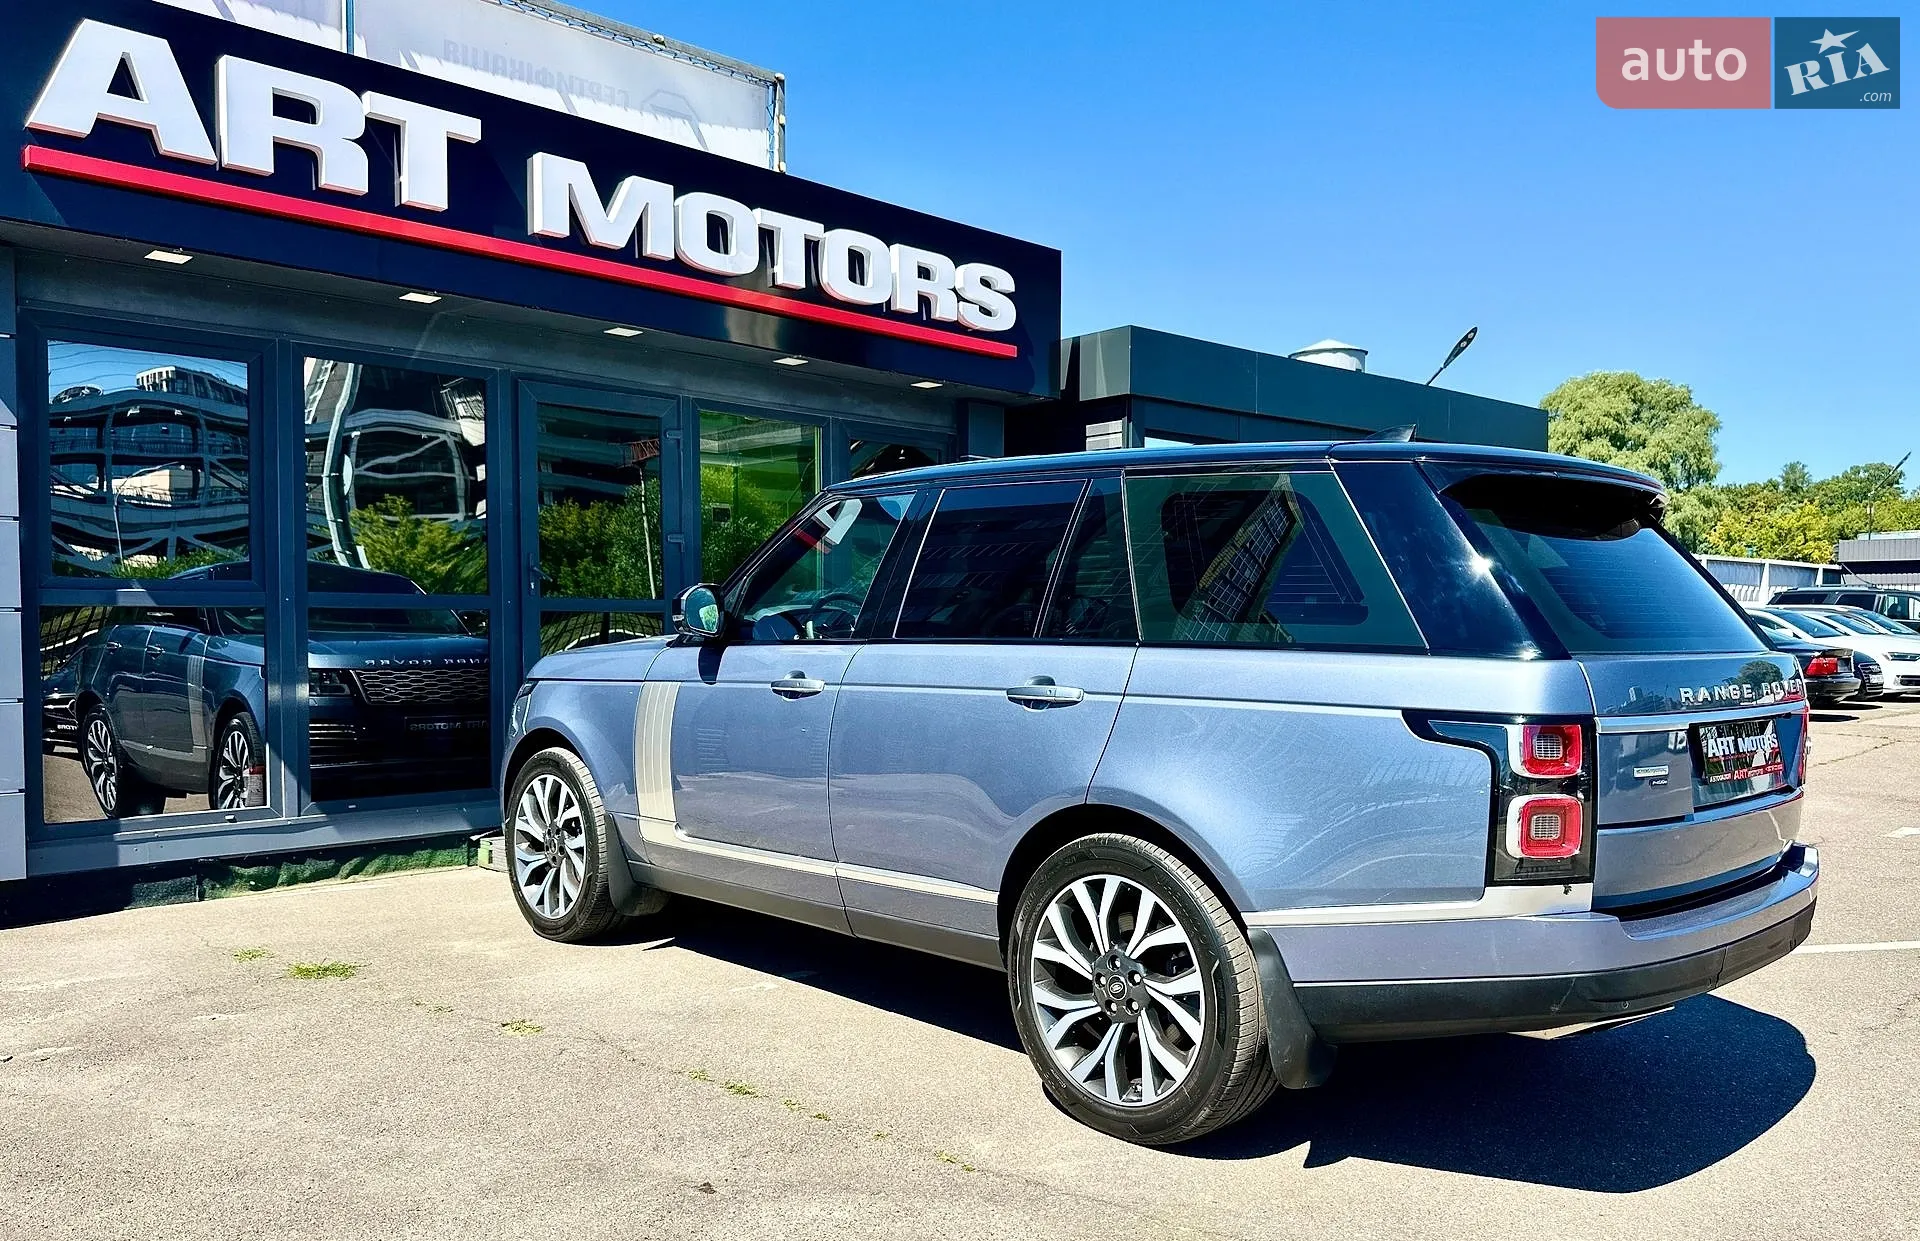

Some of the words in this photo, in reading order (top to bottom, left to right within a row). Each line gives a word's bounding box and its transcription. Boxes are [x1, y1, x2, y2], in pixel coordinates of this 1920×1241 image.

[24, 18, 482, 213] ART
[526, 151, 1018, 333] MOTORS
[1679, 683, 1755, 703] RANGE
[1762, 678, 1802, 697] ROVER
[1707, 737, 1735, 758] ART
[1737, 734, 1779, 753] MOTORS
